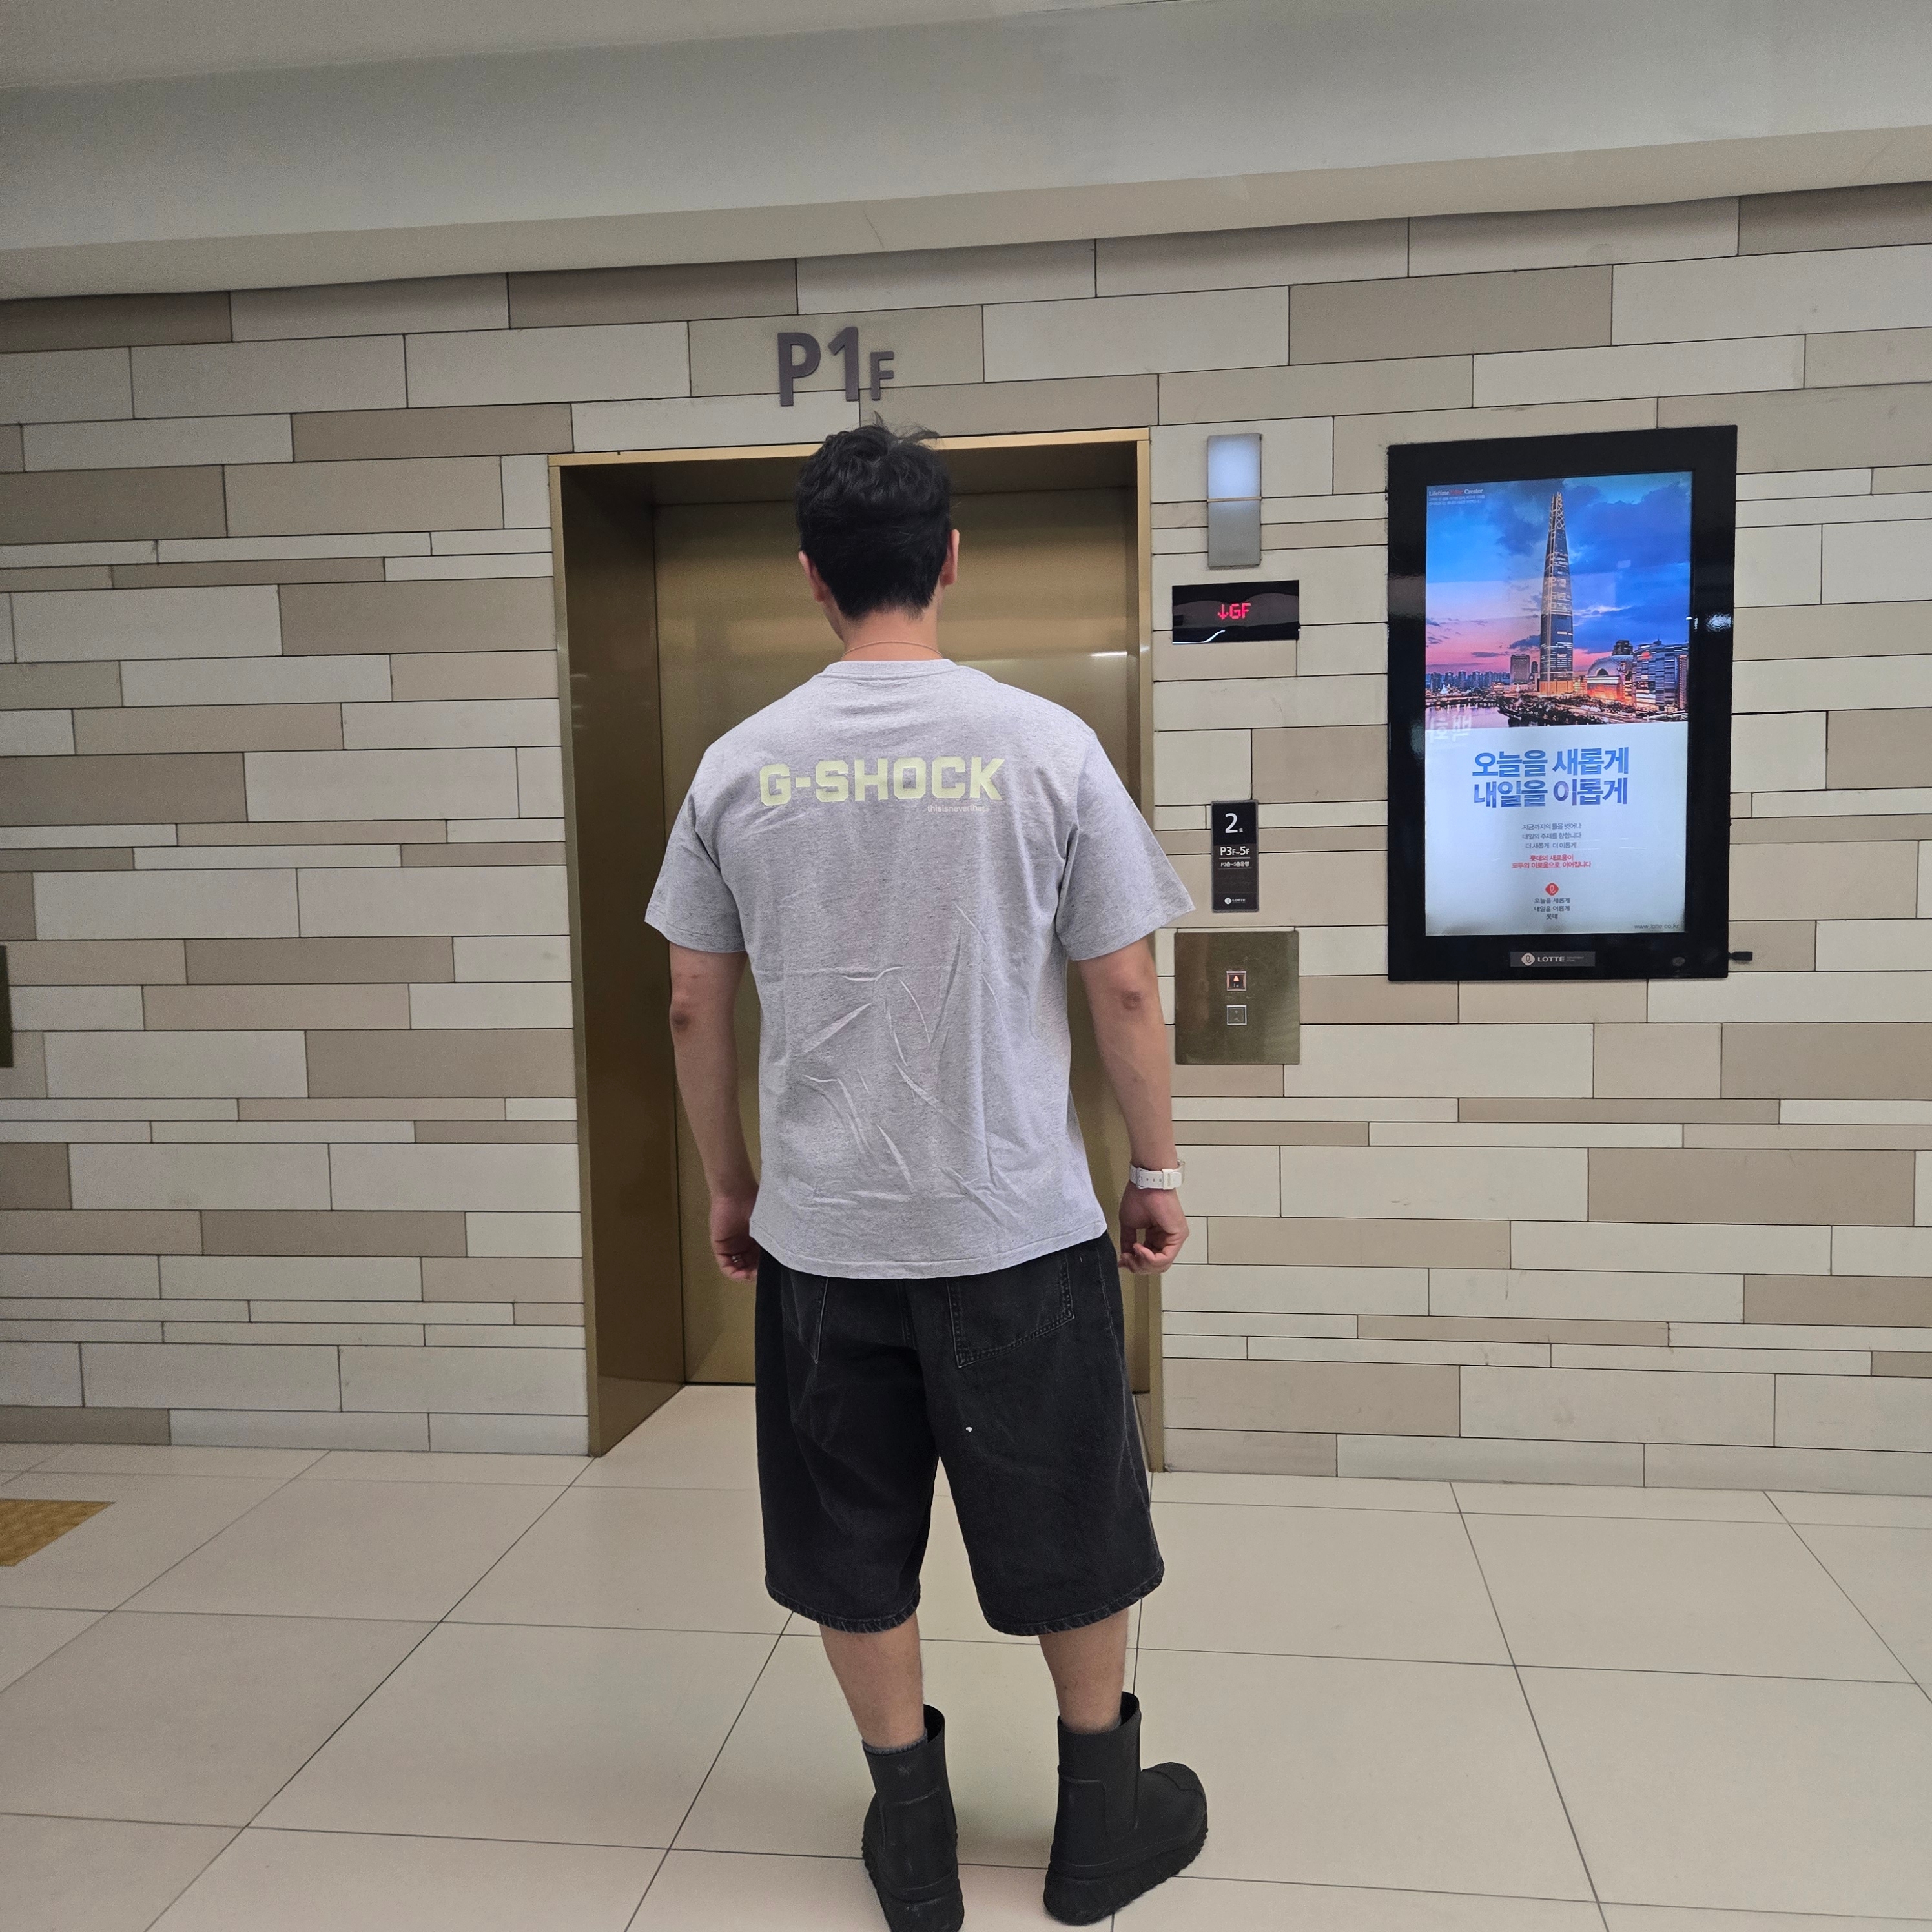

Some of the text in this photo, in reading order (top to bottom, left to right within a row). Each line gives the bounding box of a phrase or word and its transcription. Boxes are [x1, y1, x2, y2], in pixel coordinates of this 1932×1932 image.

[777, 326, 894, 407] P1F
[1229, 602, 1252, 619] GF
[1472, 747, 1629, 777] 오늘을 새롭게
[760, 756, 1005, 806] G-SHOCK
[1474, 777, 1629, 808] 내일을 이롭게
